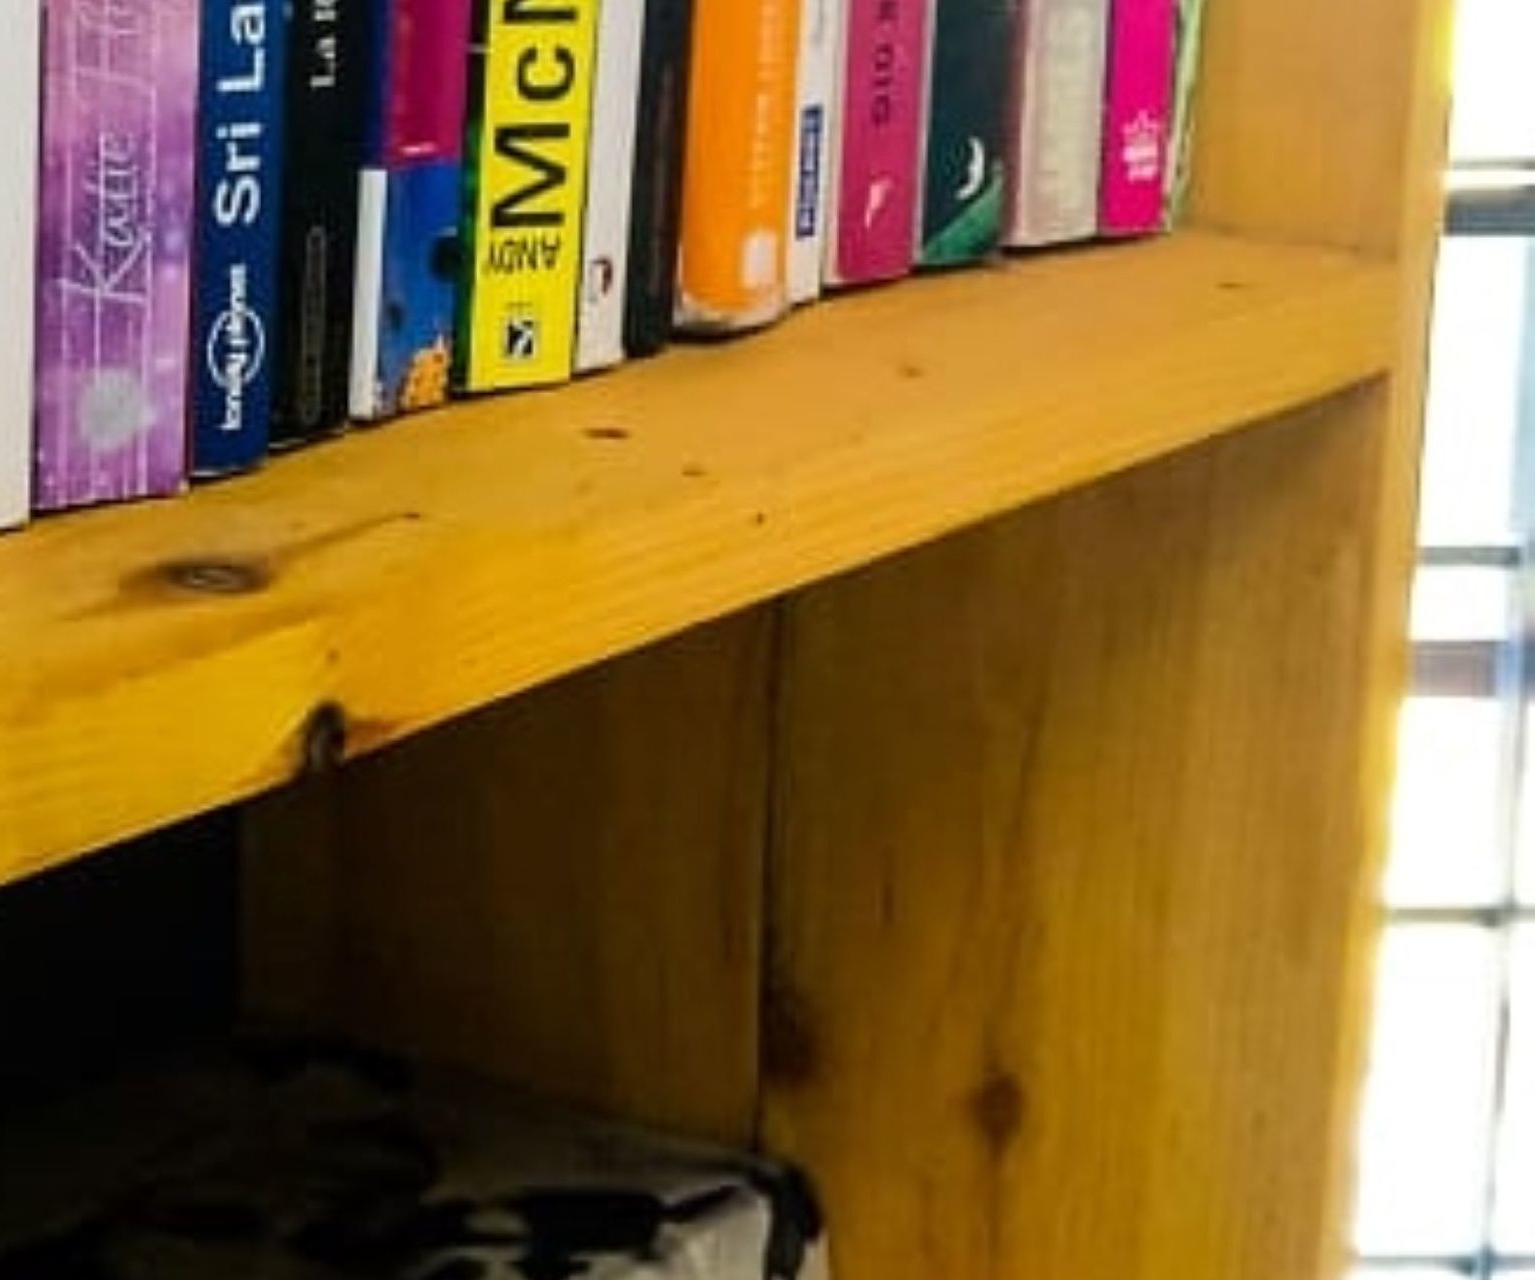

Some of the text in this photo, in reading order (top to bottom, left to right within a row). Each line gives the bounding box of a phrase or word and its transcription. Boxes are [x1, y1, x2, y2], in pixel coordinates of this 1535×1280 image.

[309, 39, 336, 88] La
[217, 126, 261, 226] Sri
[57, 130, 148, 306] Katie
[483, 235, 562, 276] ANDY
